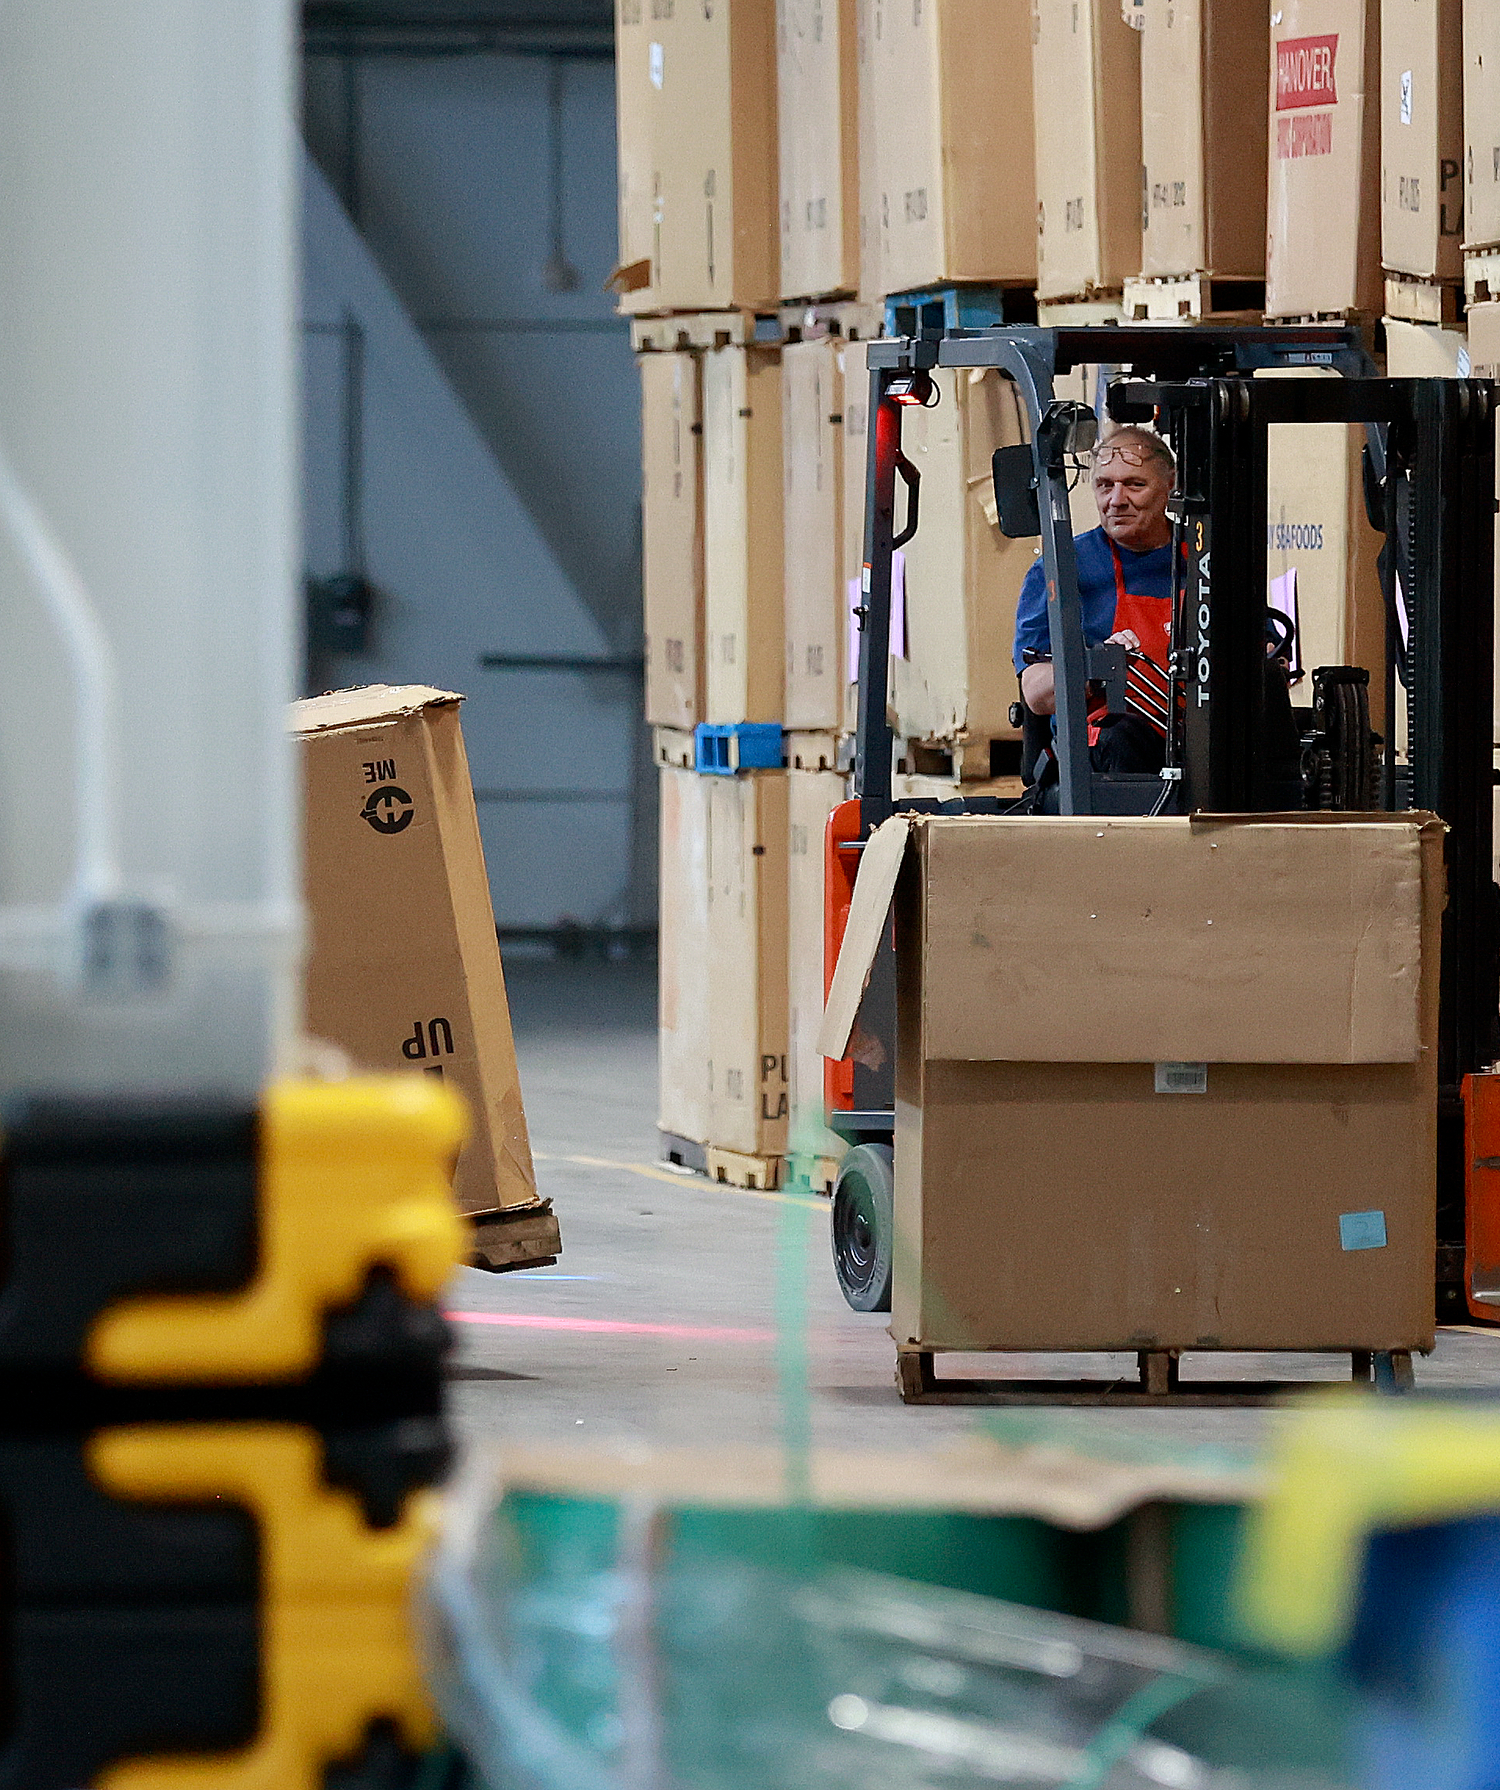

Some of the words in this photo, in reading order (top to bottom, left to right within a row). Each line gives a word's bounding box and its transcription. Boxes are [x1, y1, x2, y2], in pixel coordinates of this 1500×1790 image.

[1196, 521, 1204, 551] 3
[1276, 524, 1323, 550] SEAFOODS
[1198, 552, 1211, 708] TOYOTA
[362, 759, 396, 784] ME
[402, 1017, 455, 1060] UP
